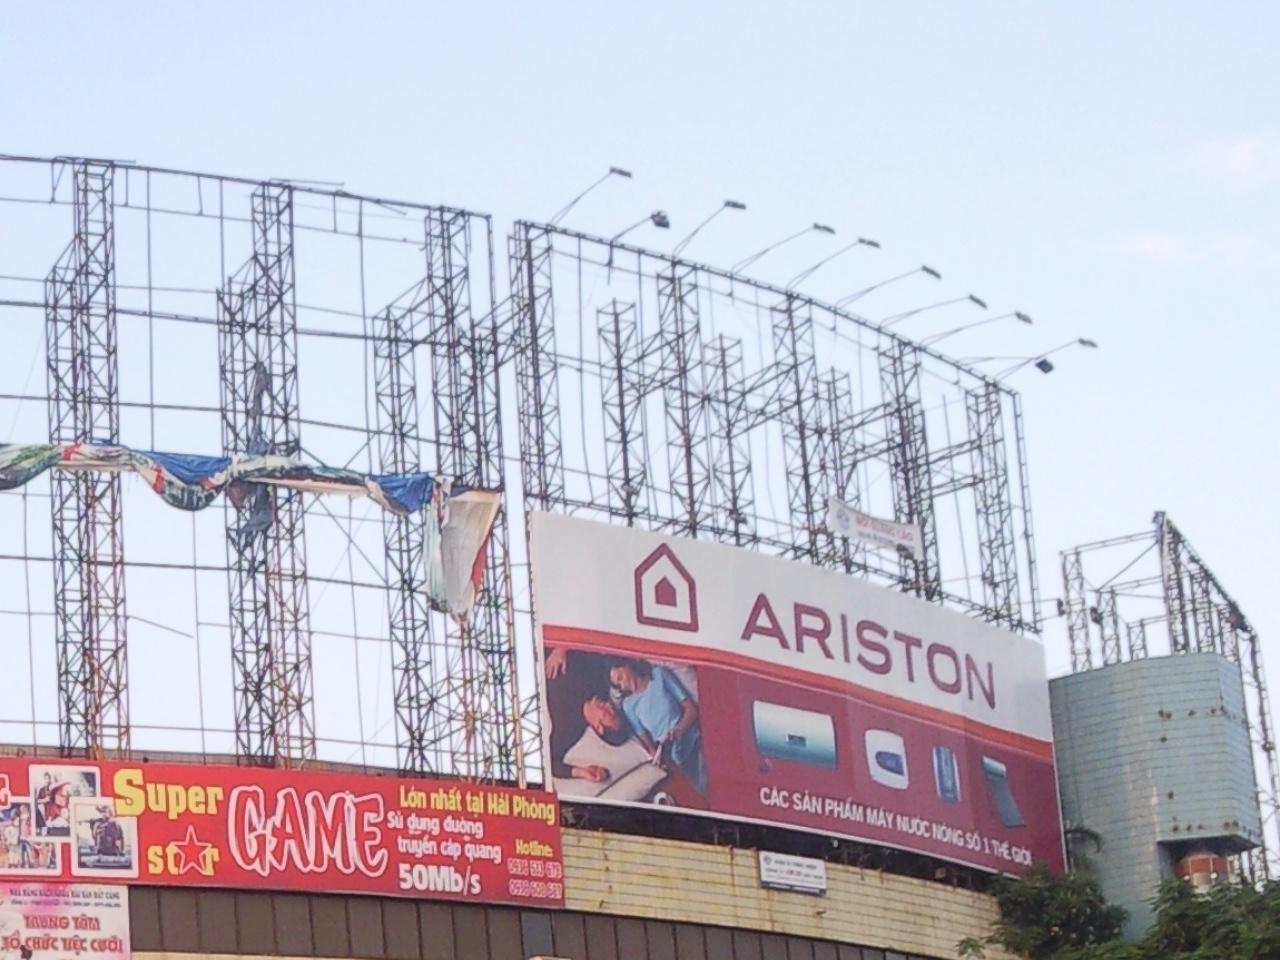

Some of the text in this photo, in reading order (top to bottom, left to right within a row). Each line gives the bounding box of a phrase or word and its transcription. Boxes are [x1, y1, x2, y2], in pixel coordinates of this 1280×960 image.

[740, 592, 996, 710] ARISTON
[113, 768, 224, 820] Super
[400, 785, 555, 826] Lớn nhất tại Hải Phòng
[759, 786, 789, 809] CÁC
[792, 789, 822, 815] SẢN
[227, 784, 389, 878] GAME
[464, 843, 502, 864] quang
[399, 863, 481, 896] 50Mb/s
